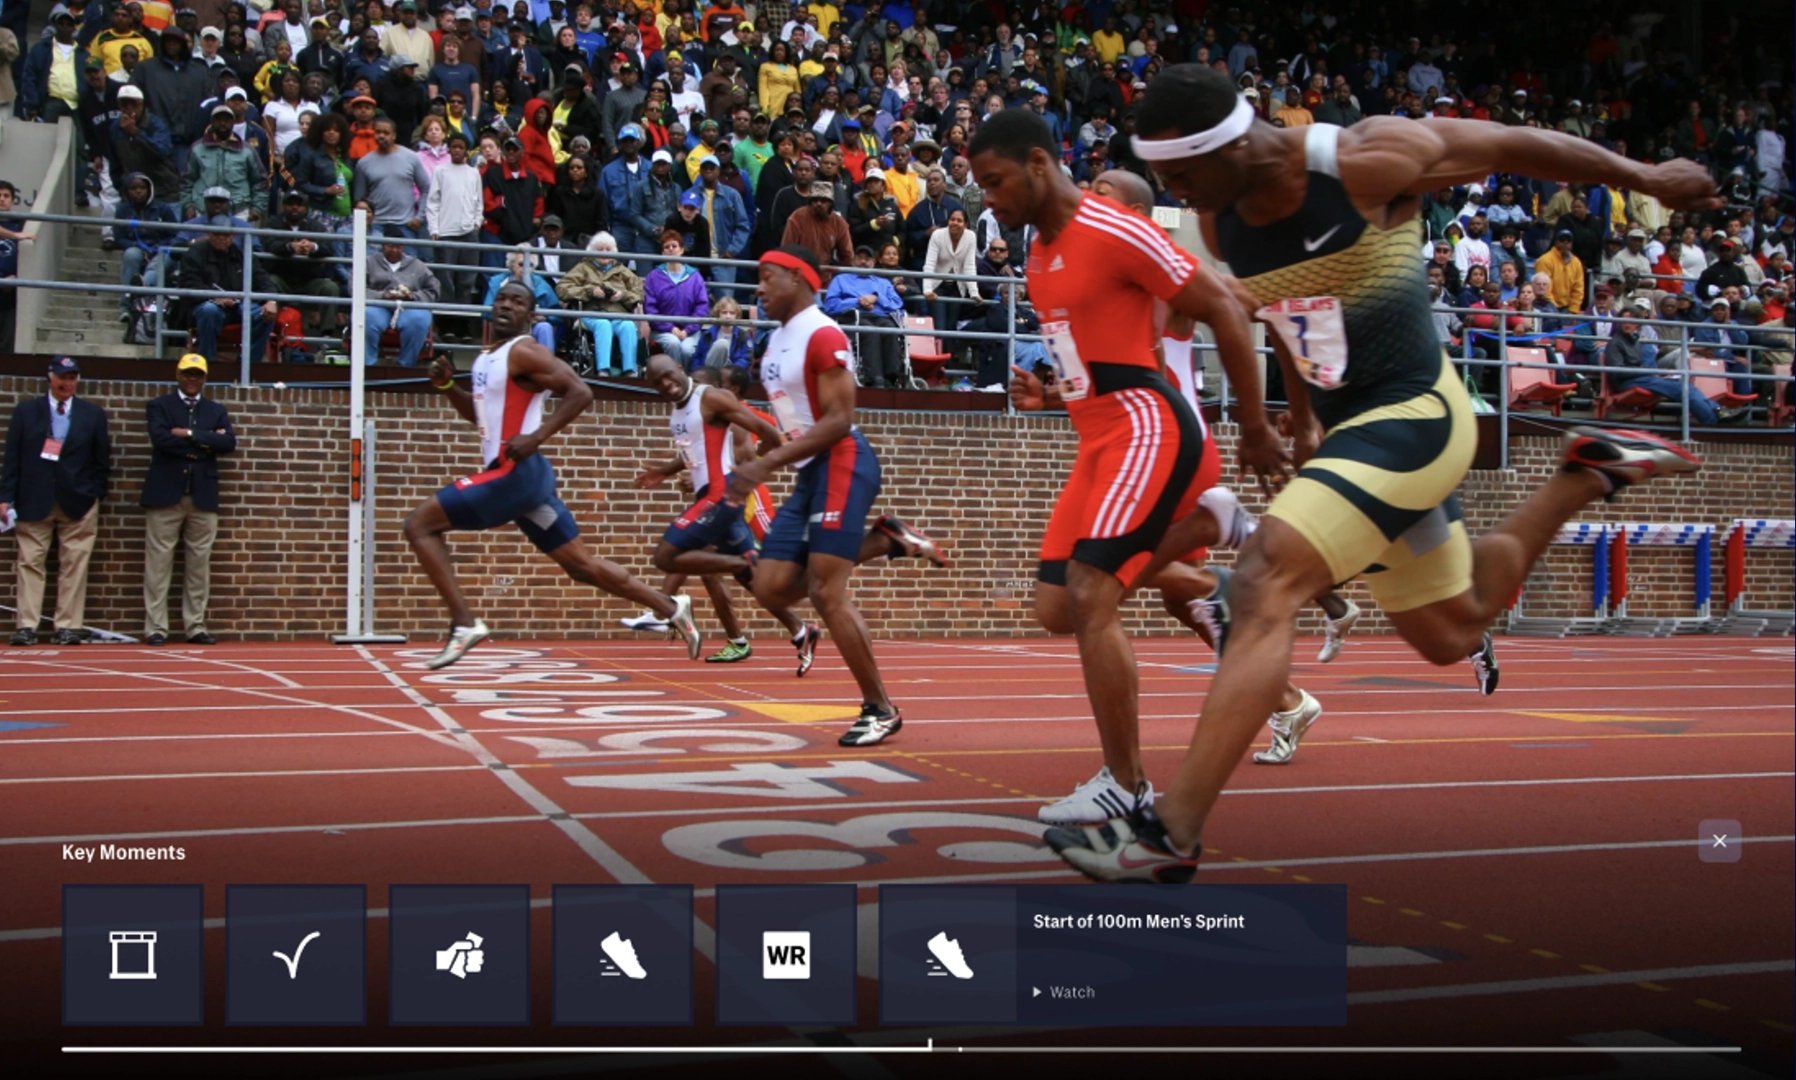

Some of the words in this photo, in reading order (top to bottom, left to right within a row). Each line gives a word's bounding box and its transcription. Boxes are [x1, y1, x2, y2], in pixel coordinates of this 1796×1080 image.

[1289, 315, 1308, 358] 7
[419, 672, 621, 684] 8
[478, 705, 728, 723] 6
[502, 729, 809, 758] 5
[563, 760, 922, 799] 4
[661, 811, 1062, 870] 3
